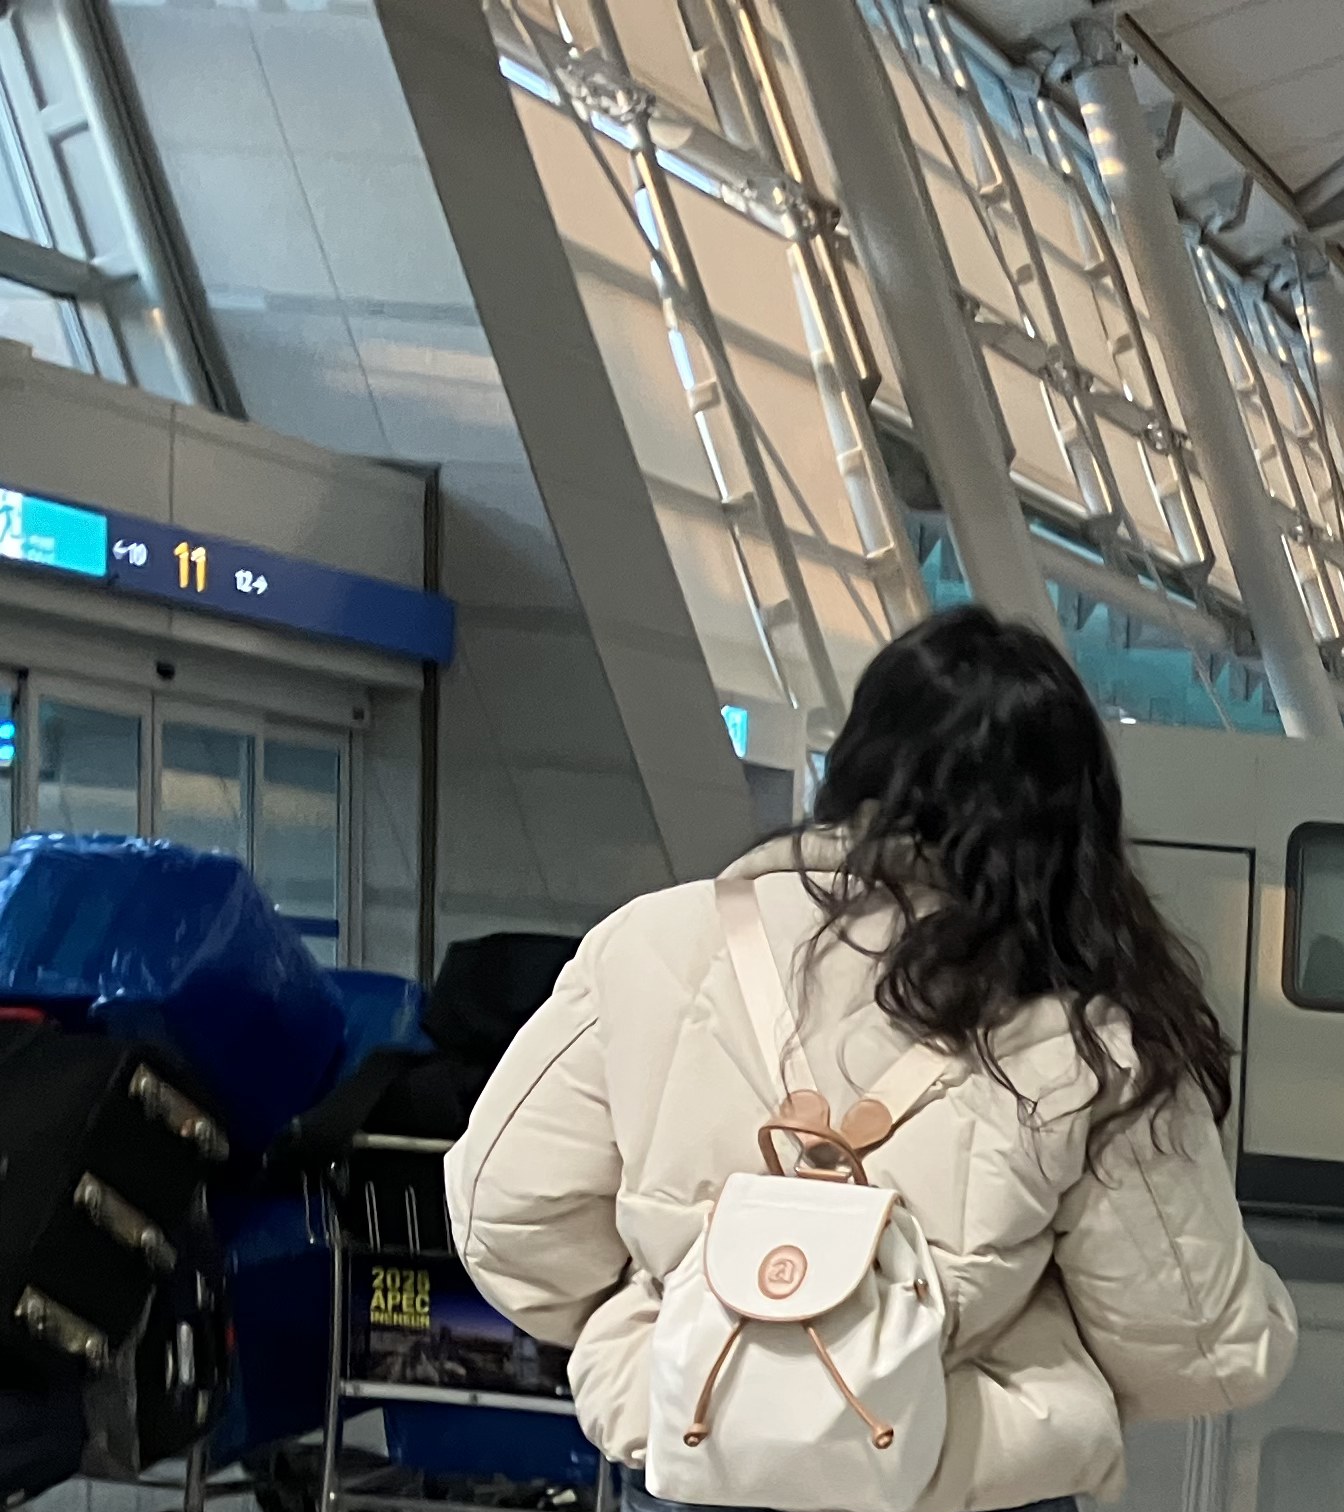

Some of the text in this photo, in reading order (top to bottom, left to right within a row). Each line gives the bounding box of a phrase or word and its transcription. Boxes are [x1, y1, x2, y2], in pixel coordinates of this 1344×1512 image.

[129, 541, 253, 593] 10 11 12
[370, 1289, 430, 1313] APEC
